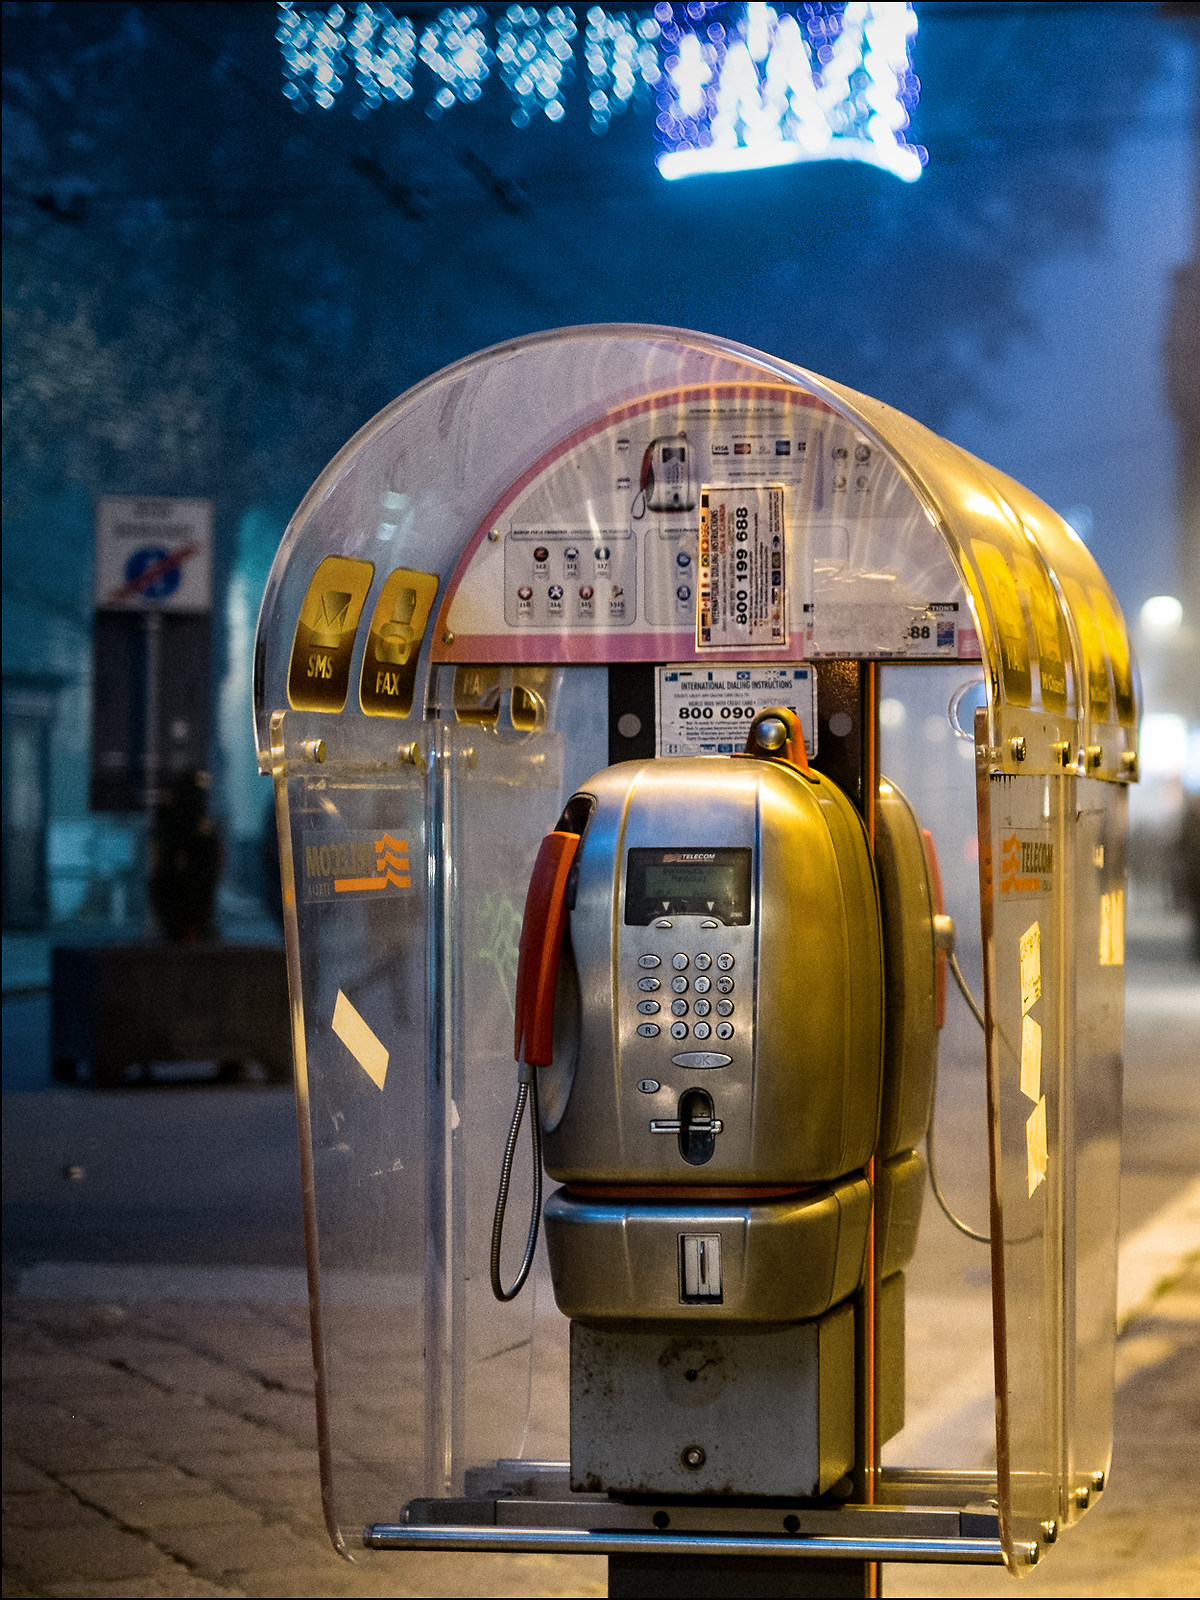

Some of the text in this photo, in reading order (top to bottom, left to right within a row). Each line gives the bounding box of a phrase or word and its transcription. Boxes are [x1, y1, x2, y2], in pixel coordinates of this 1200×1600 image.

[711, 510, 719, 625] INTERNATIONAL DIALING INSTRUCTIONS
[736, 507, 748, 625] 800 199 688
[307, 654, 333, 680] SMS
[375, 672, 400, 696] FAX
[681, 680, 793, 690] INTERNATIONAL DIALING INSTRUCTIONS
[679, 707, 713, 719] 800
[720, 707, 755, 719] 090
[1022, 842, 1053, 873] TELECOM
